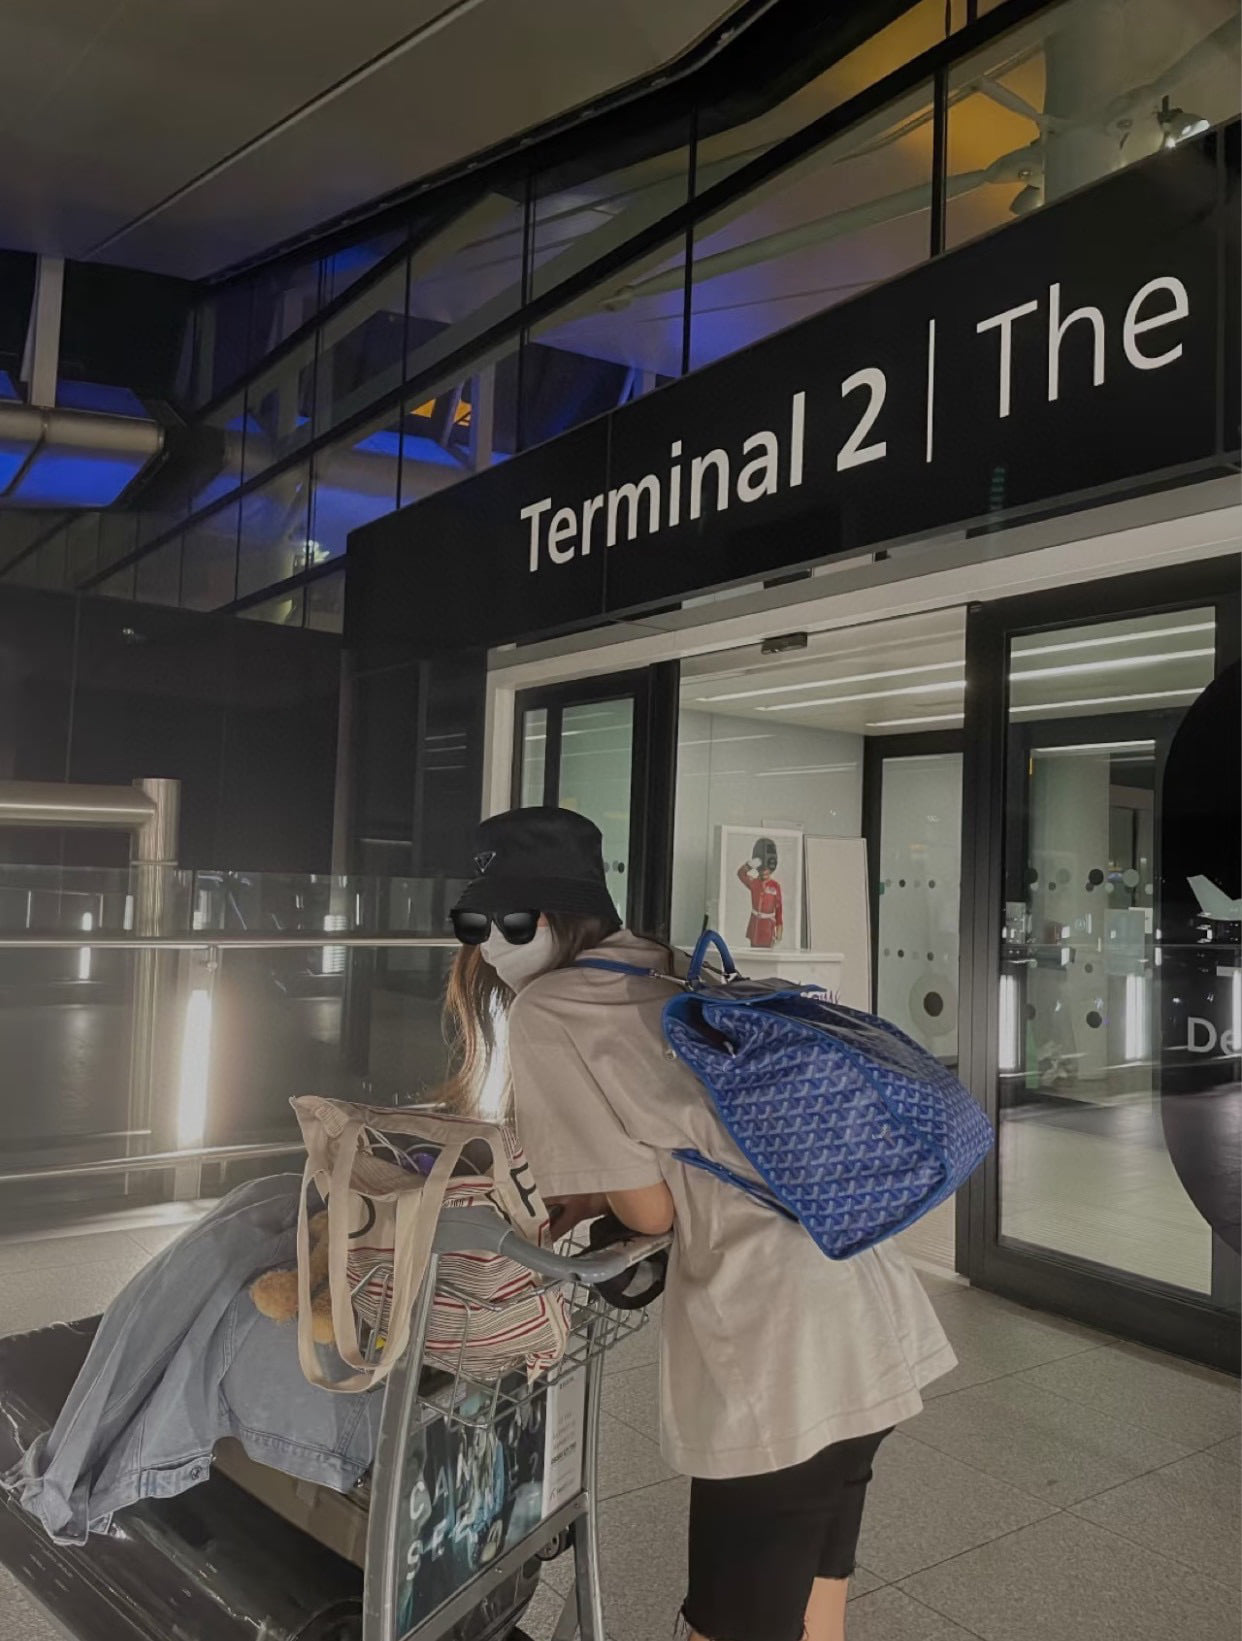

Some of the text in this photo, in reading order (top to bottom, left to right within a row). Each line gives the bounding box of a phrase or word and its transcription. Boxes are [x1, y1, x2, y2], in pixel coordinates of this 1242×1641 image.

[520, 276, 1190, 572] Terminal 2 The
